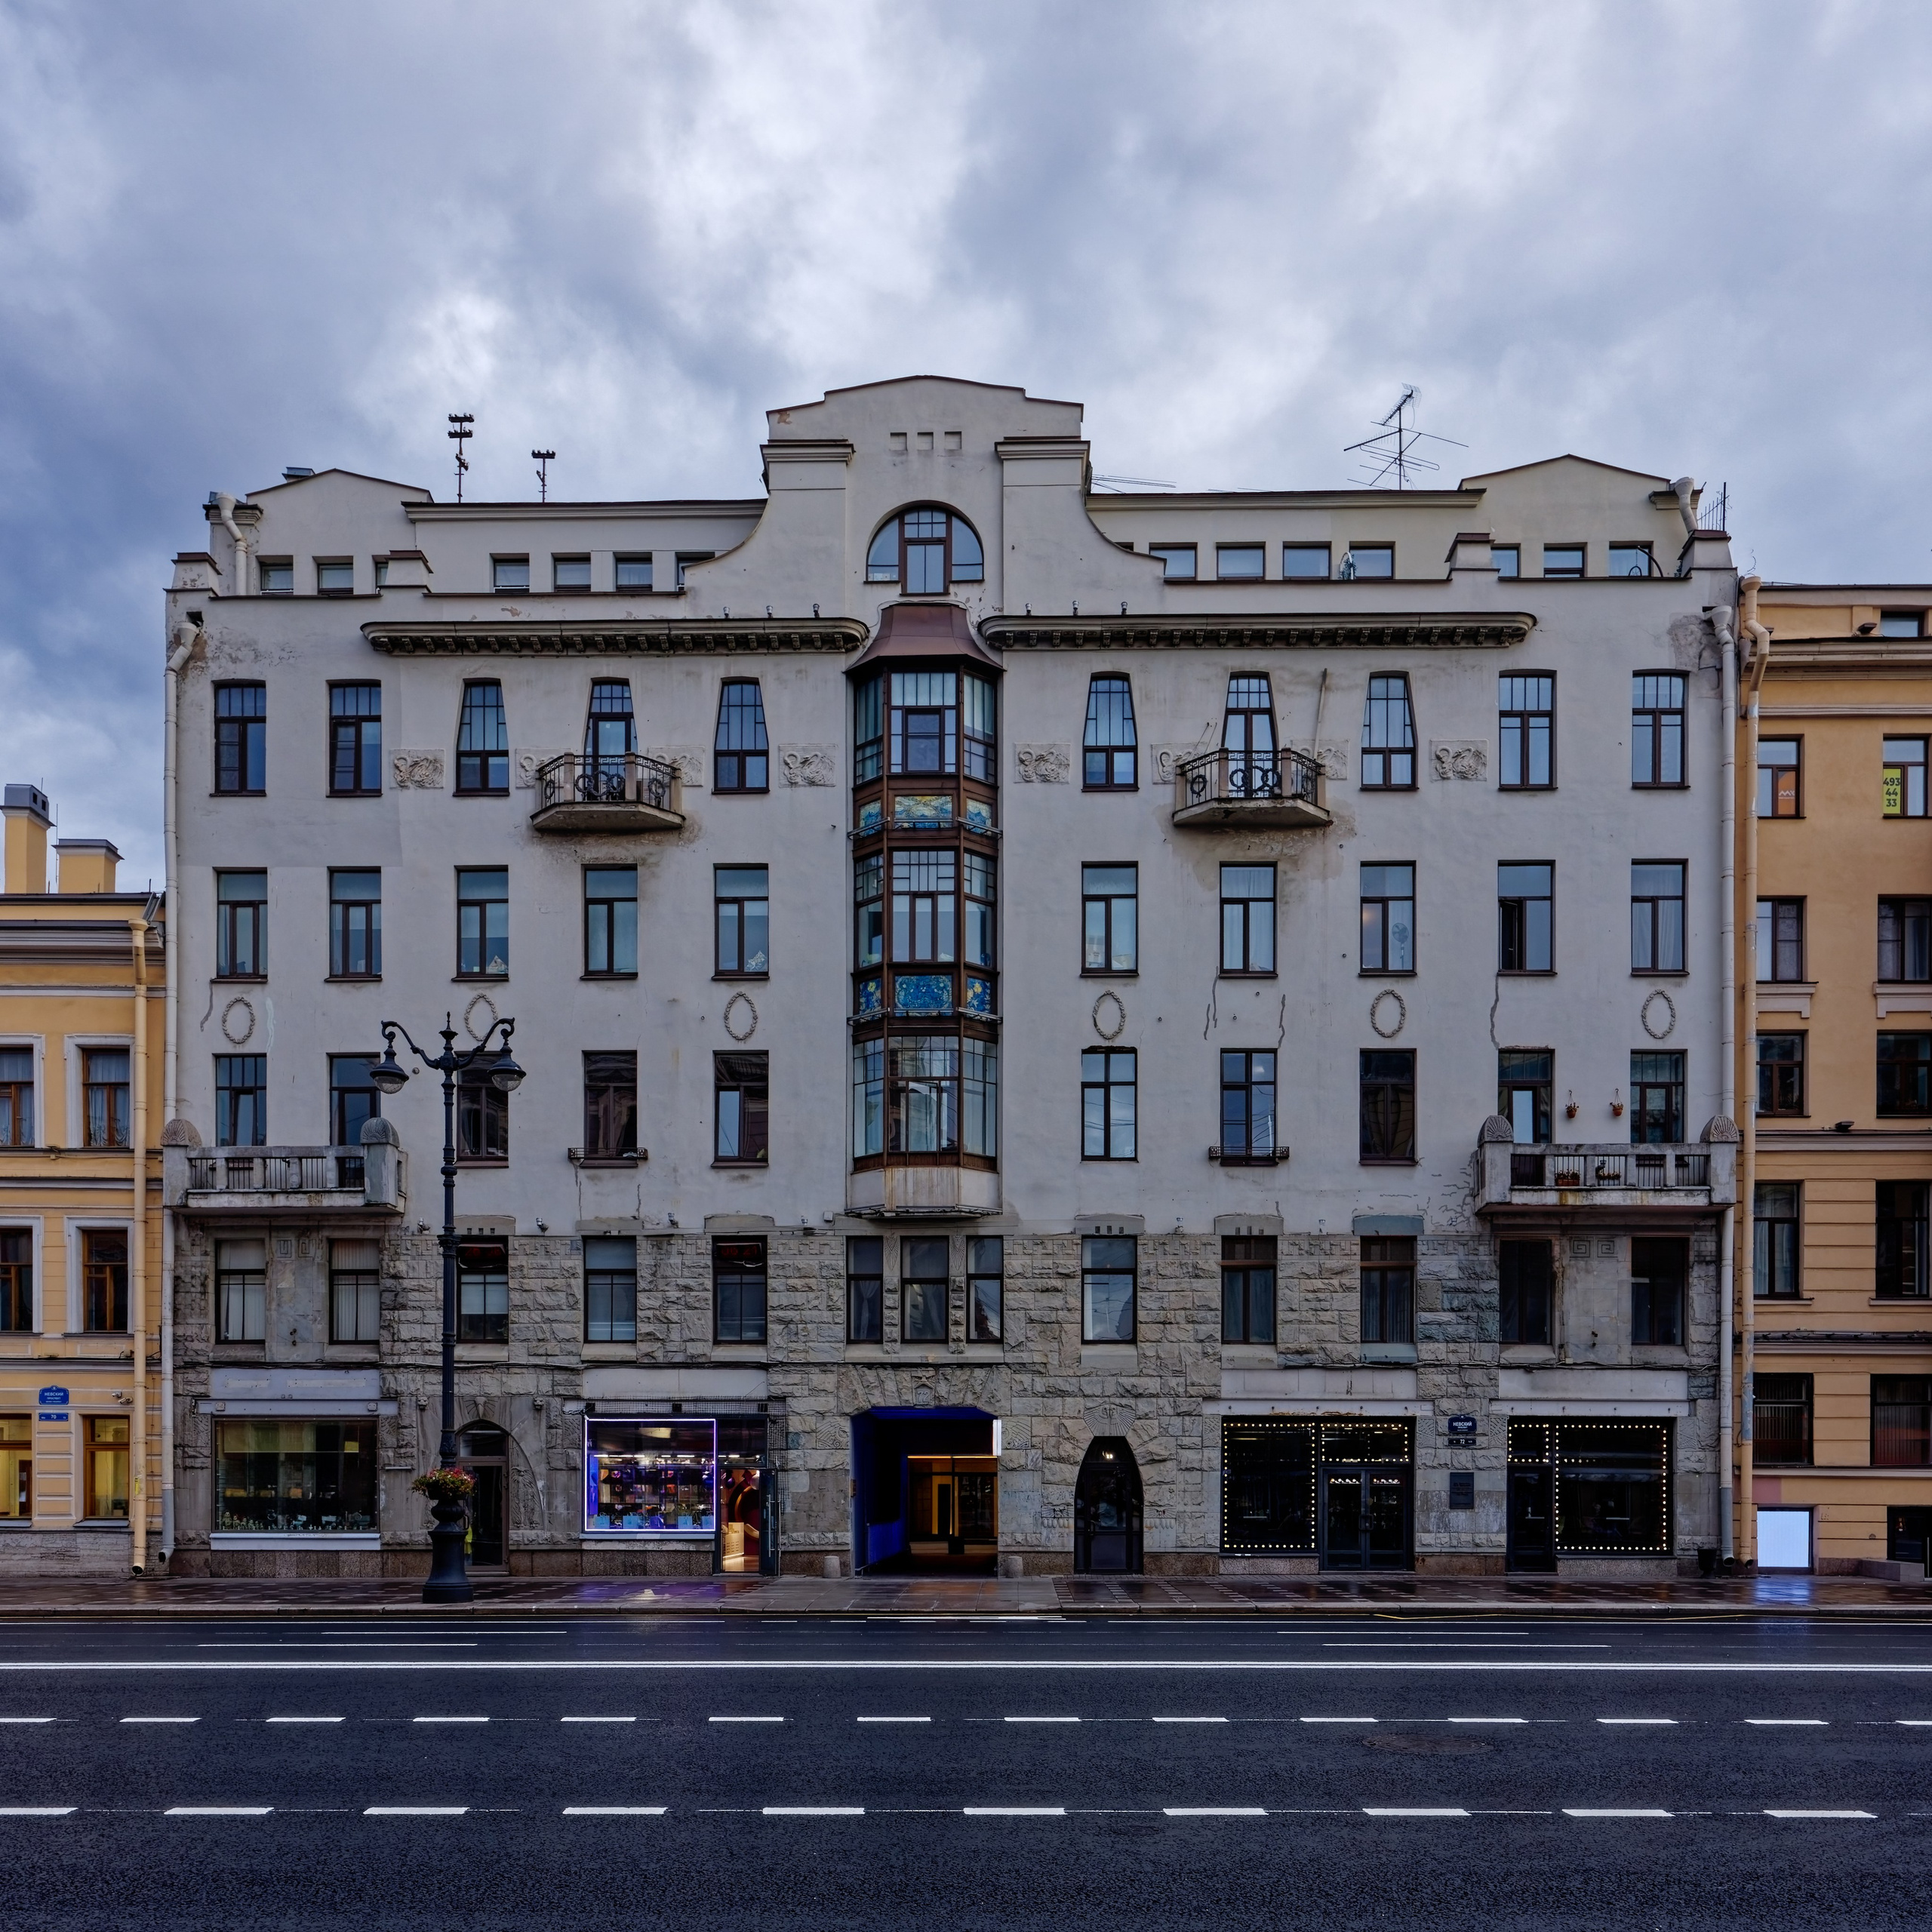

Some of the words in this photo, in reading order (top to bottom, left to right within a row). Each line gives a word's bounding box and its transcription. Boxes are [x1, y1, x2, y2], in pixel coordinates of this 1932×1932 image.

[1883, 777, 1900, 786] 493
[1885, 788, 1898, 796] 44
[1886, 798, 1897, 807] 33
[917, 1390, 930, 1404] 72
